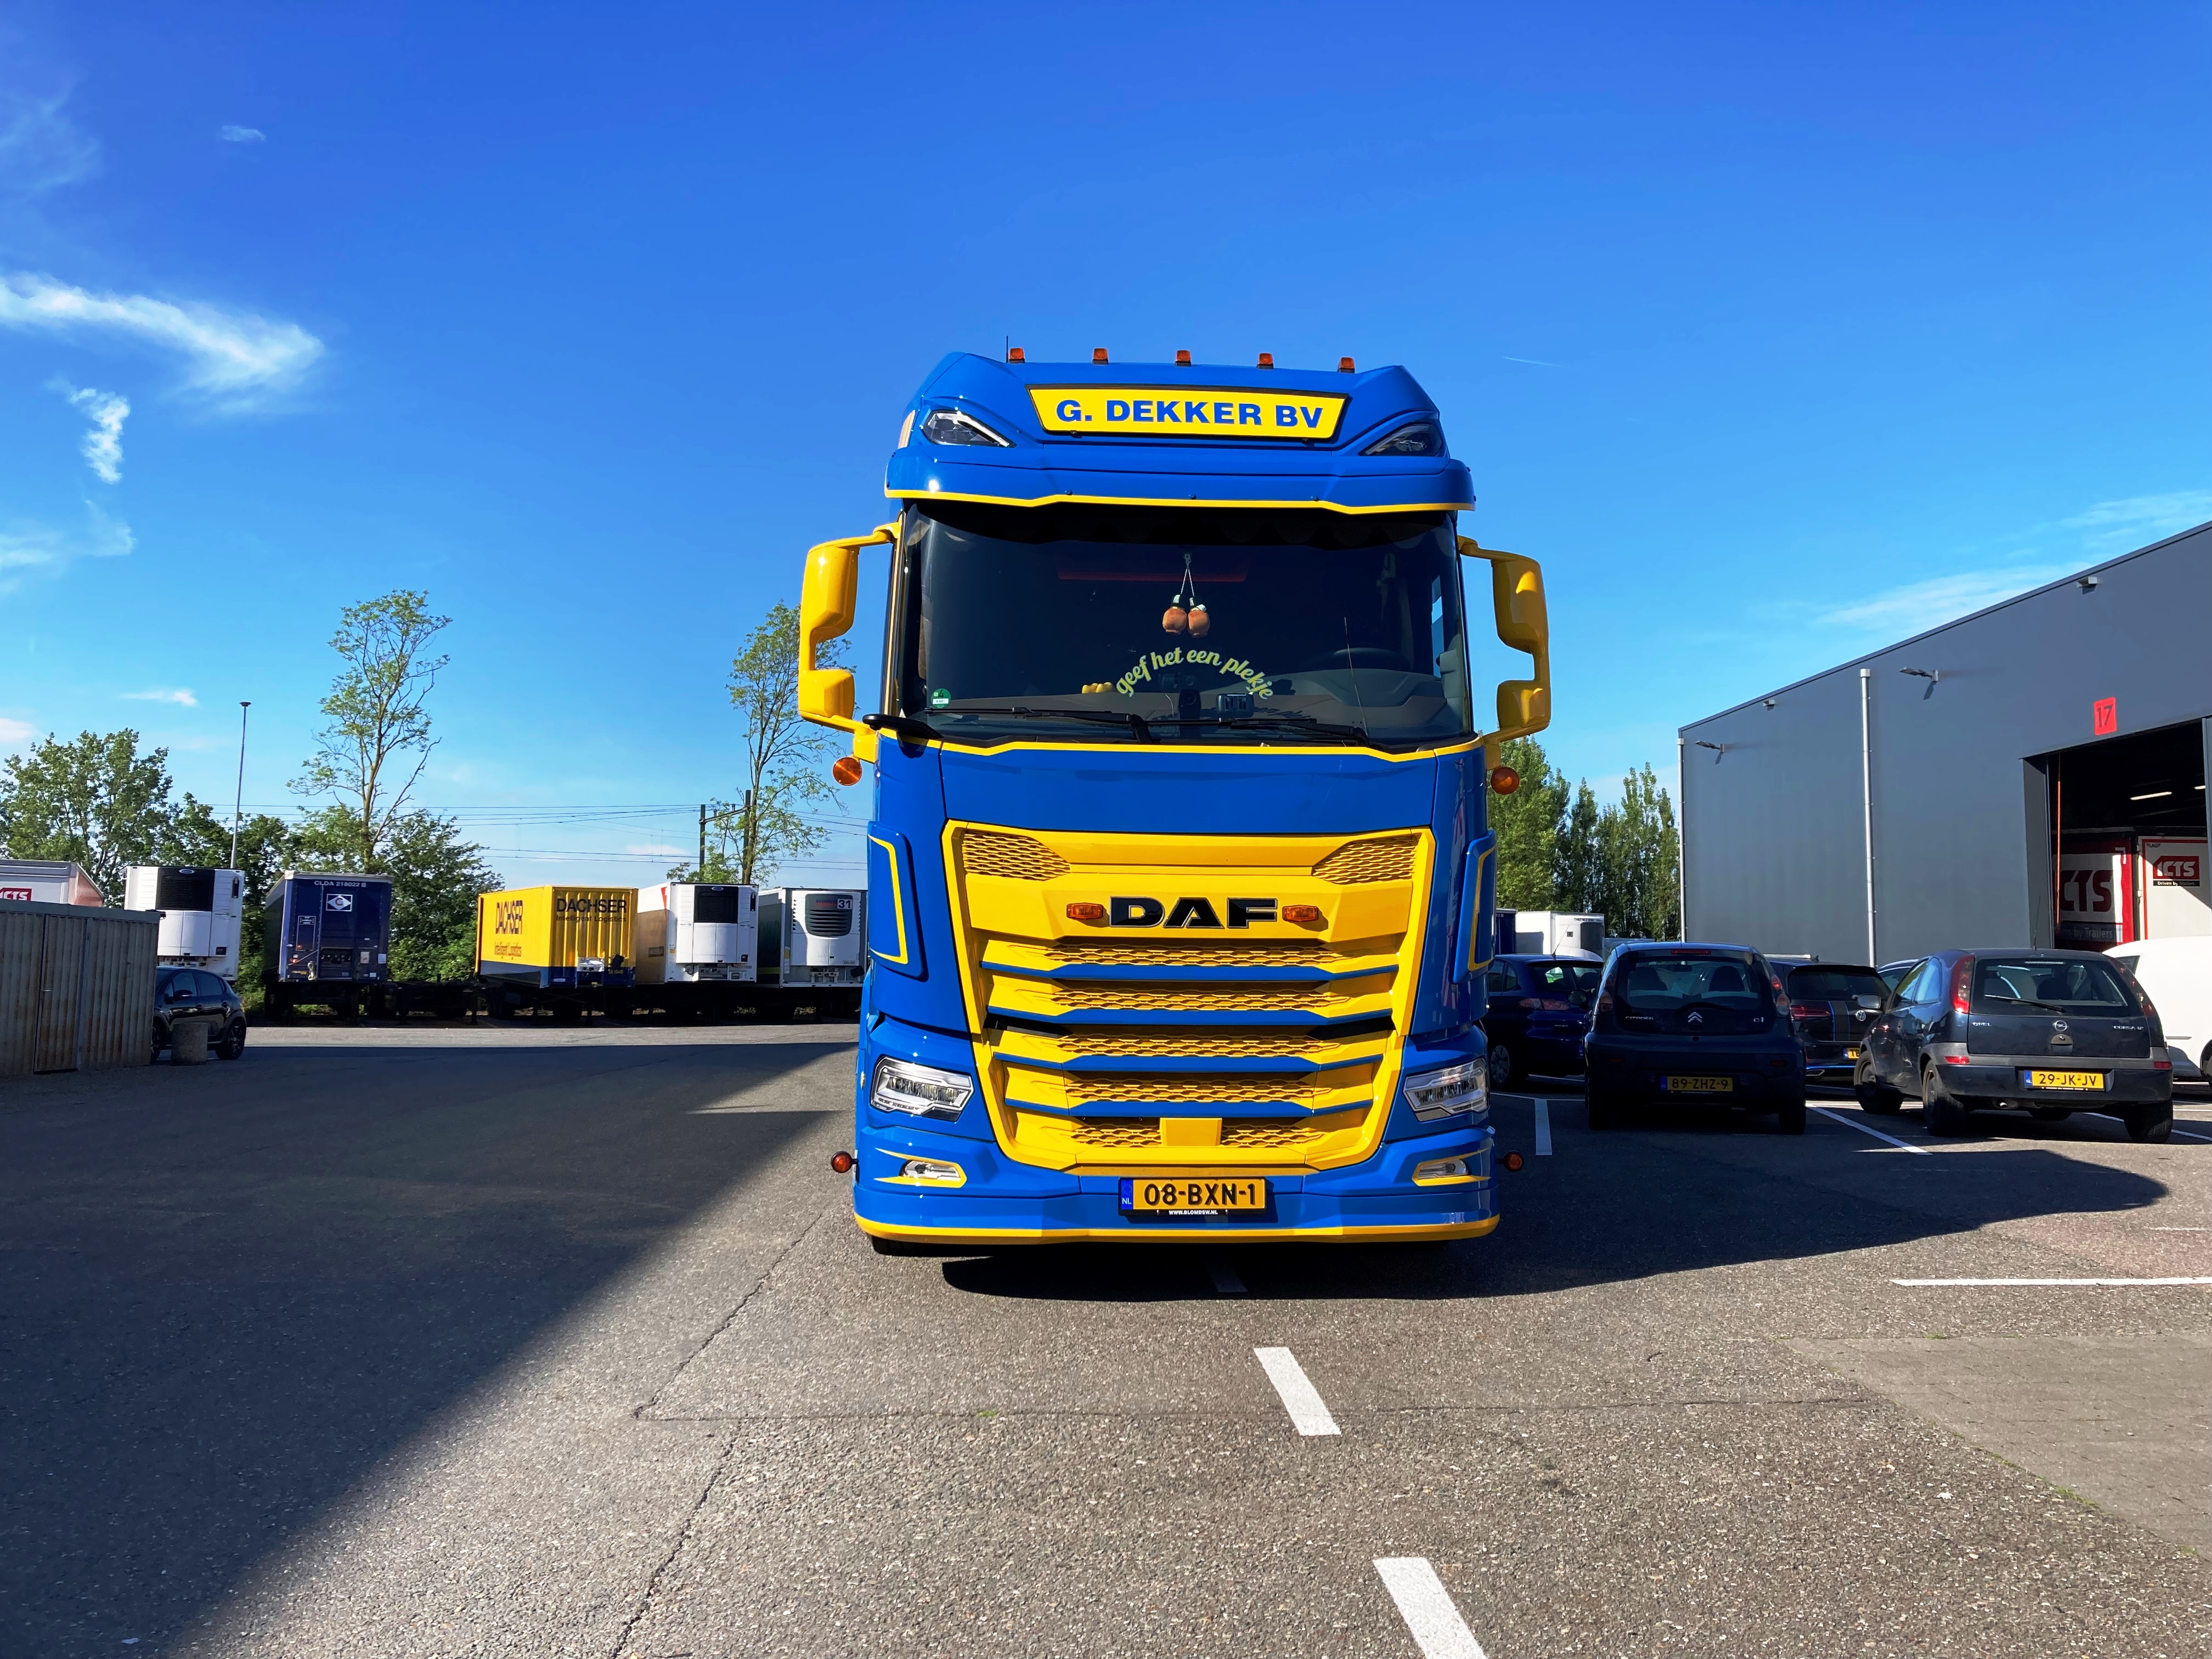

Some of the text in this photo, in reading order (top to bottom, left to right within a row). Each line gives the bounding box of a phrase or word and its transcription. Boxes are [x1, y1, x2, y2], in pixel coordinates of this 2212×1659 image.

[1056, 399, 1323, 429] G. DEKKER BV
[1116, 646, 1273, 699] geef het een plekje
[2096, 704, 2113, 727] 17
[2157, 861, 2196, 877] ICTS
[556, 898, 627, 913] DACHSER
[838, 900, 851, 909] 31
[1109, 896, 1278, 929] DAF
[495, 900, 523, 935] DACHSER
[594, 915, 627, 923] Logistics
[2085, 927, 2113, 938] Trailers
[1672, 1078, 1729, 1090] 89-ZHZ-9
[2039, 1074, 2097, 1086] 29-JK-JV
[1144, 1183, 1256, 1206] 08-BXN-1
